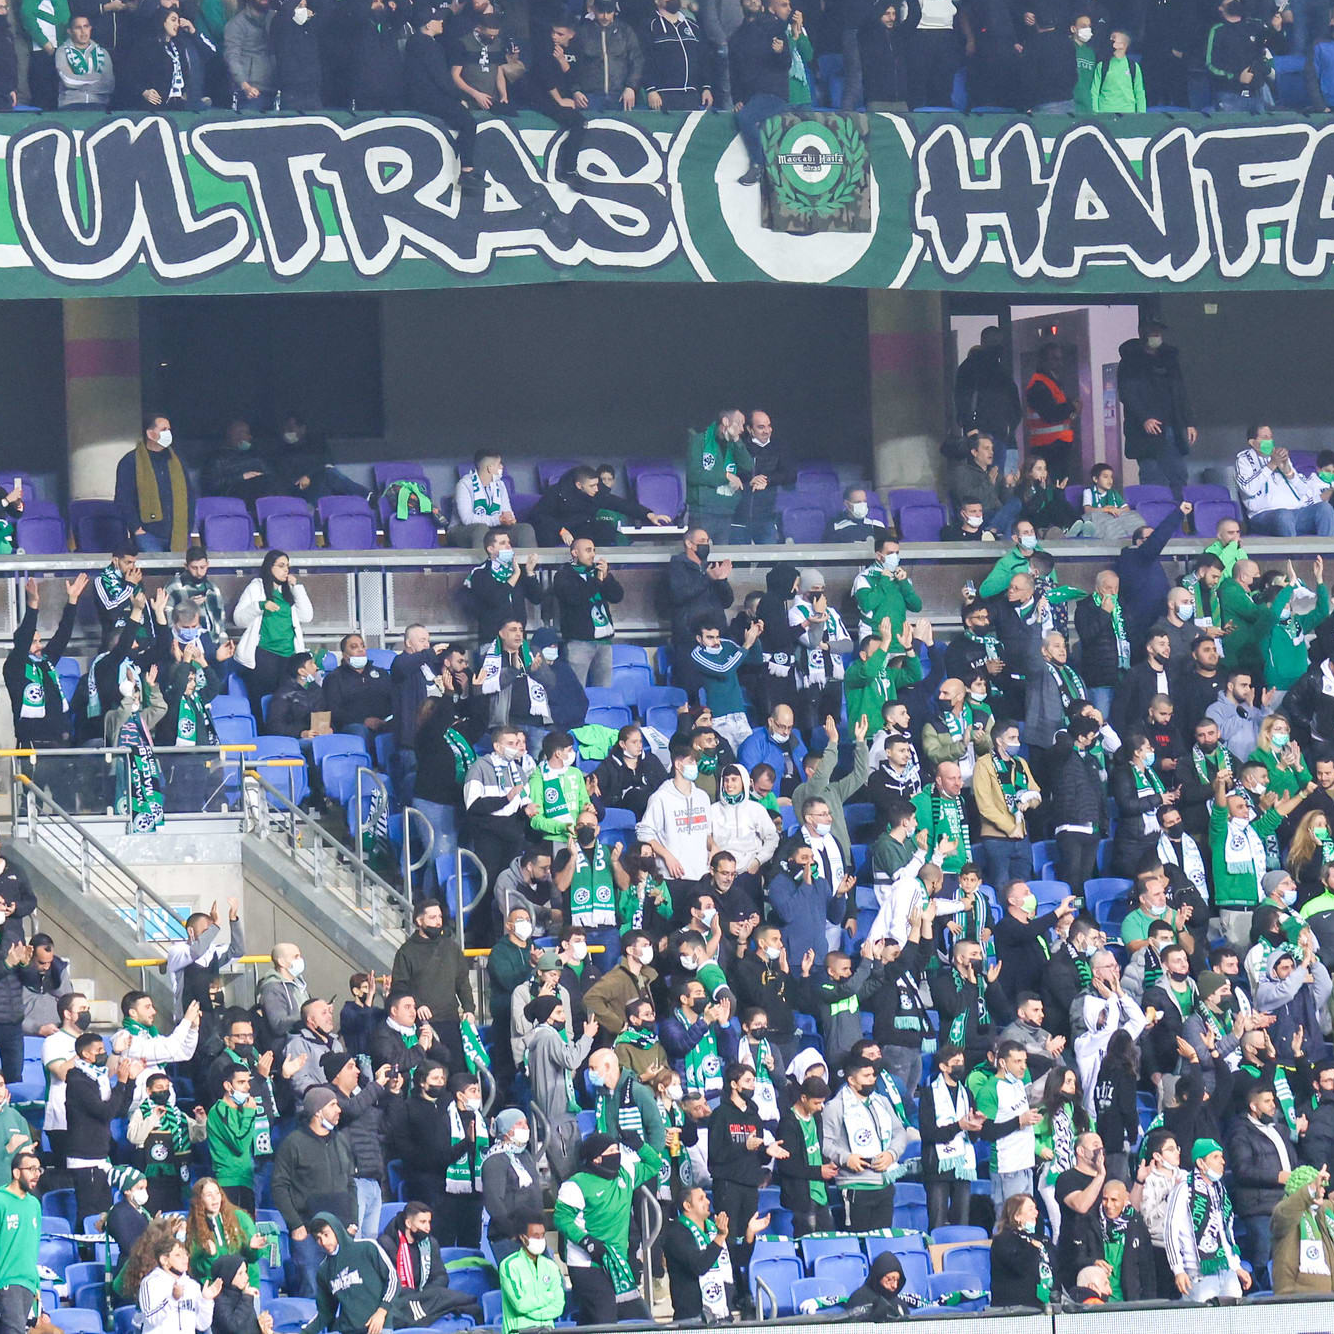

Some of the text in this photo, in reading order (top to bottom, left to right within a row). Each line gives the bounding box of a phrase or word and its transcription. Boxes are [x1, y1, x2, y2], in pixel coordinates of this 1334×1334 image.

[778, 153, 844, 164] Maccabi Haifa
[9, 115, 680, 280] ULTRAS
[674, 807, 705, 817] UNDER
